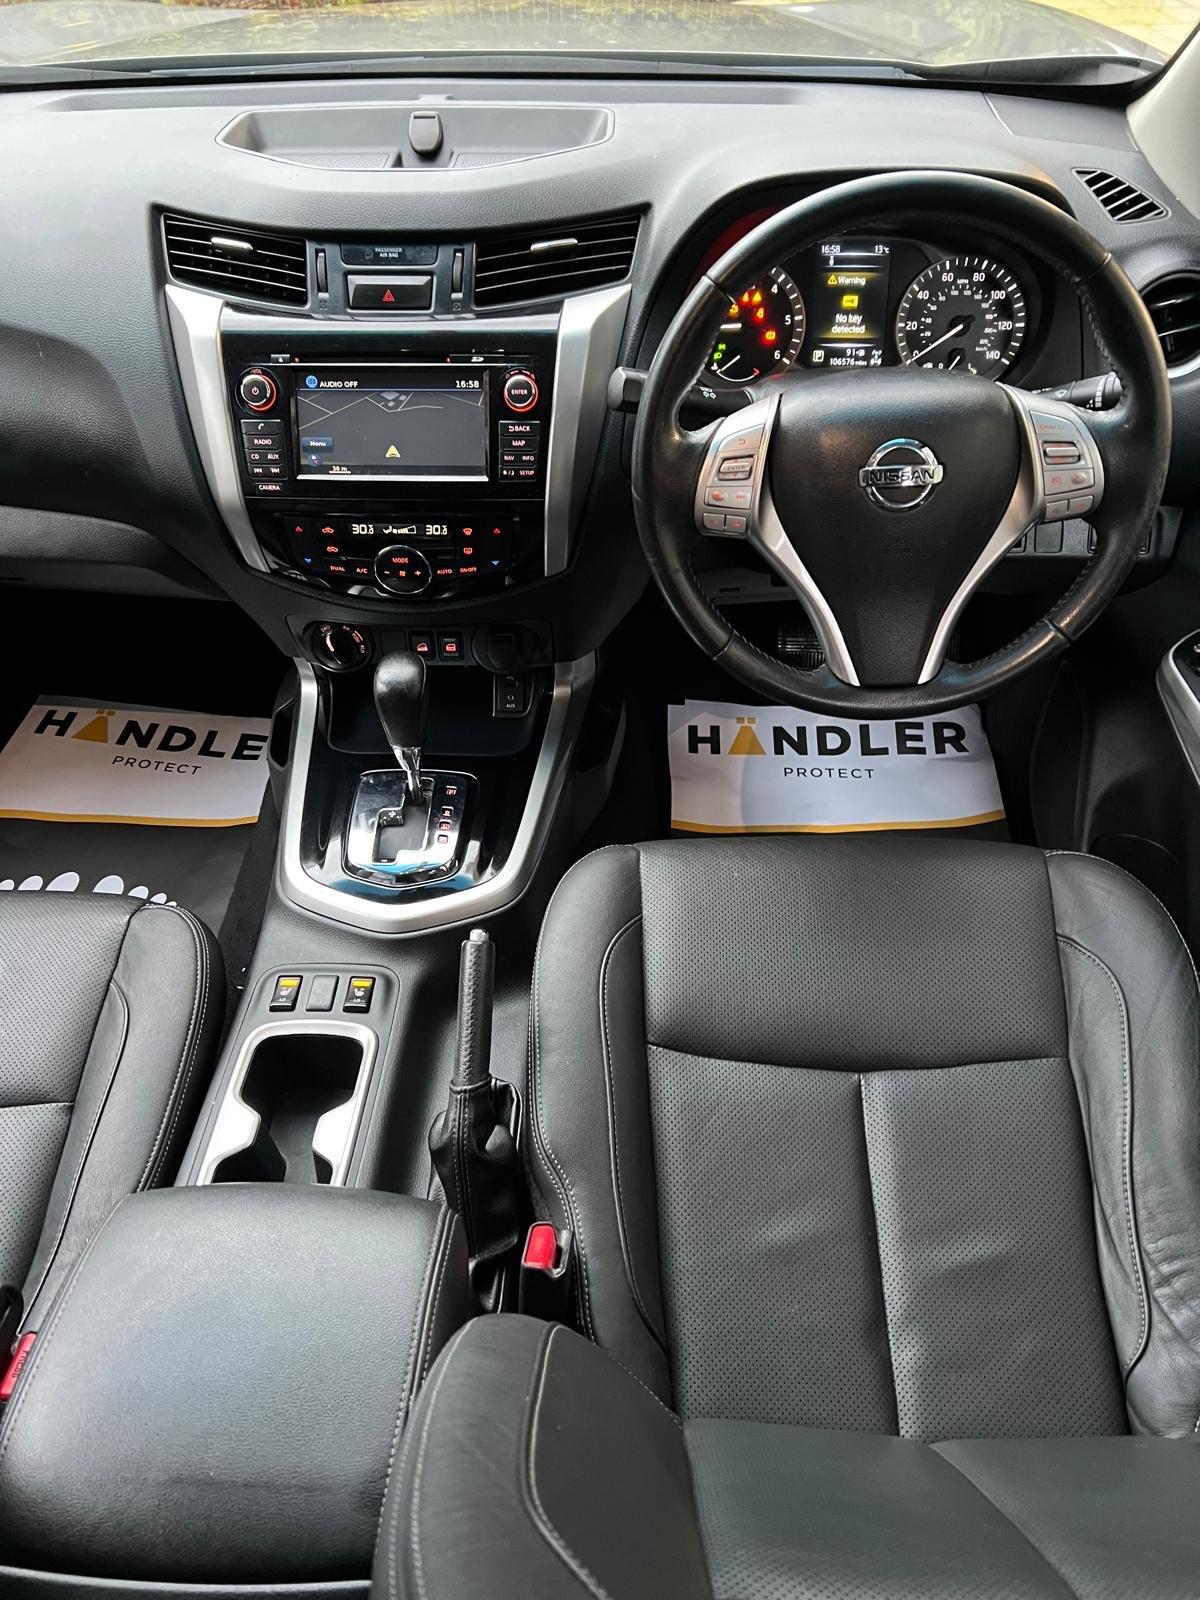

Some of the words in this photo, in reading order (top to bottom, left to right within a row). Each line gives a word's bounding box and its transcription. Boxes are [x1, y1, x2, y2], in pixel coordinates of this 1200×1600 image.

[821, 245, 841, 254] 16:58
[838, 276, 866, 286] Warning
[942, 272, 954, 282] 60
[973, 272, 986, 282] 80
[771, 284, 778, 294] 4
[917, 290, 930, 300] 40
[990, 290, 1006, 300] 100
[784, 314, 792, 325] 5
[835, 313, 846, 323] No
[848, 313, 862, 325] key
[831, 324, 866, 334] detected
[905, 321, 918, 331] 20
[998, 321, 1012, 331] 120
[773, 350, 781, 360] 6
[846, 349, 855, 357] 91
[985, 350, 1001, 360] 140
[830, 357, 855, 366] 106576
[938, 361, 944, 369] 0
[319, 380, 343, 388] AUDIO
[344, 380, 358, 388] OFF
[455, 380, 480, 388] 16:58
[869, 469, 935, 484] NISSAN
[34, 709, 269, 761] HÄNDLE
[687, 716, 970, 755] HÄNDLER
[112, 755, 202, 775] PROTECT
[783, 767, 875, 779] PROTECT
